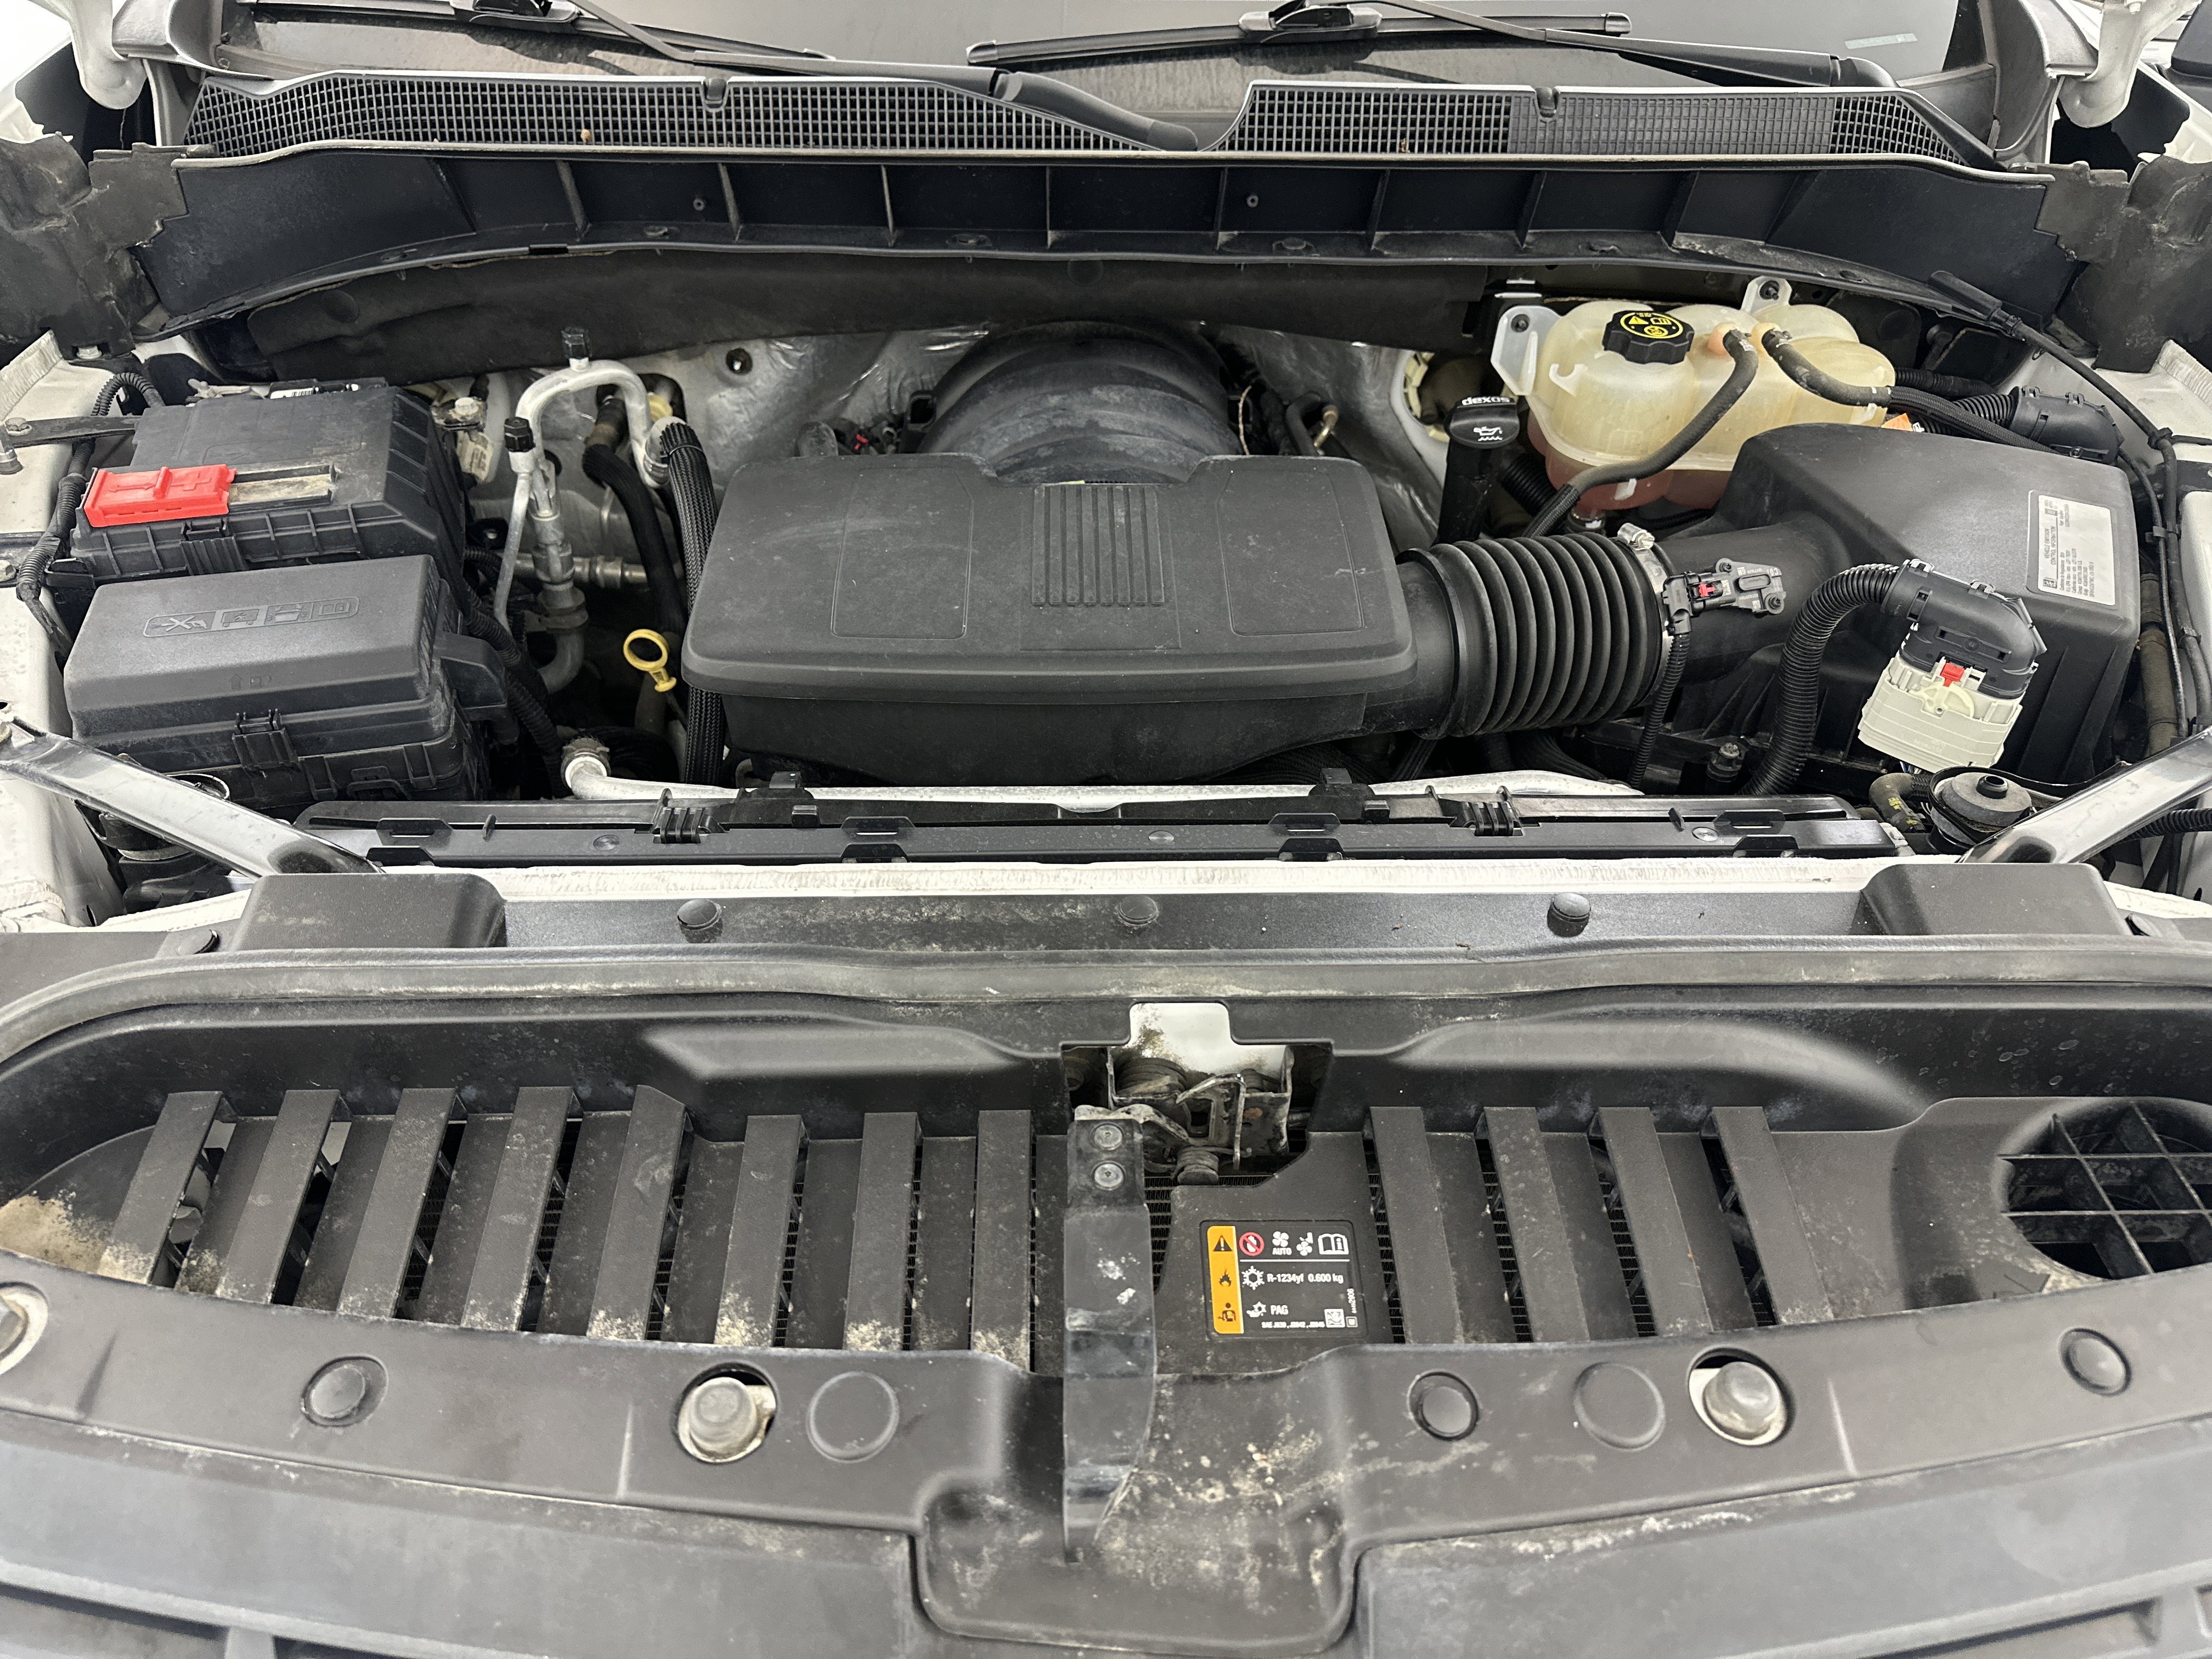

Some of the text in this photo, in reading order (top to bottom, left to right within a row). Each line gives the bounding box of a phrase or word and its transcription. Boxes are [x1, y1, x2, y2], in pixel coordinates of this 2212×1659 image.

[1462, 397, 1510, 405] dexos
[1267, 1273, 1344, 1284] R-1234yf 0.600 kg
[1271, 1305, 1289, 1315] PAG
